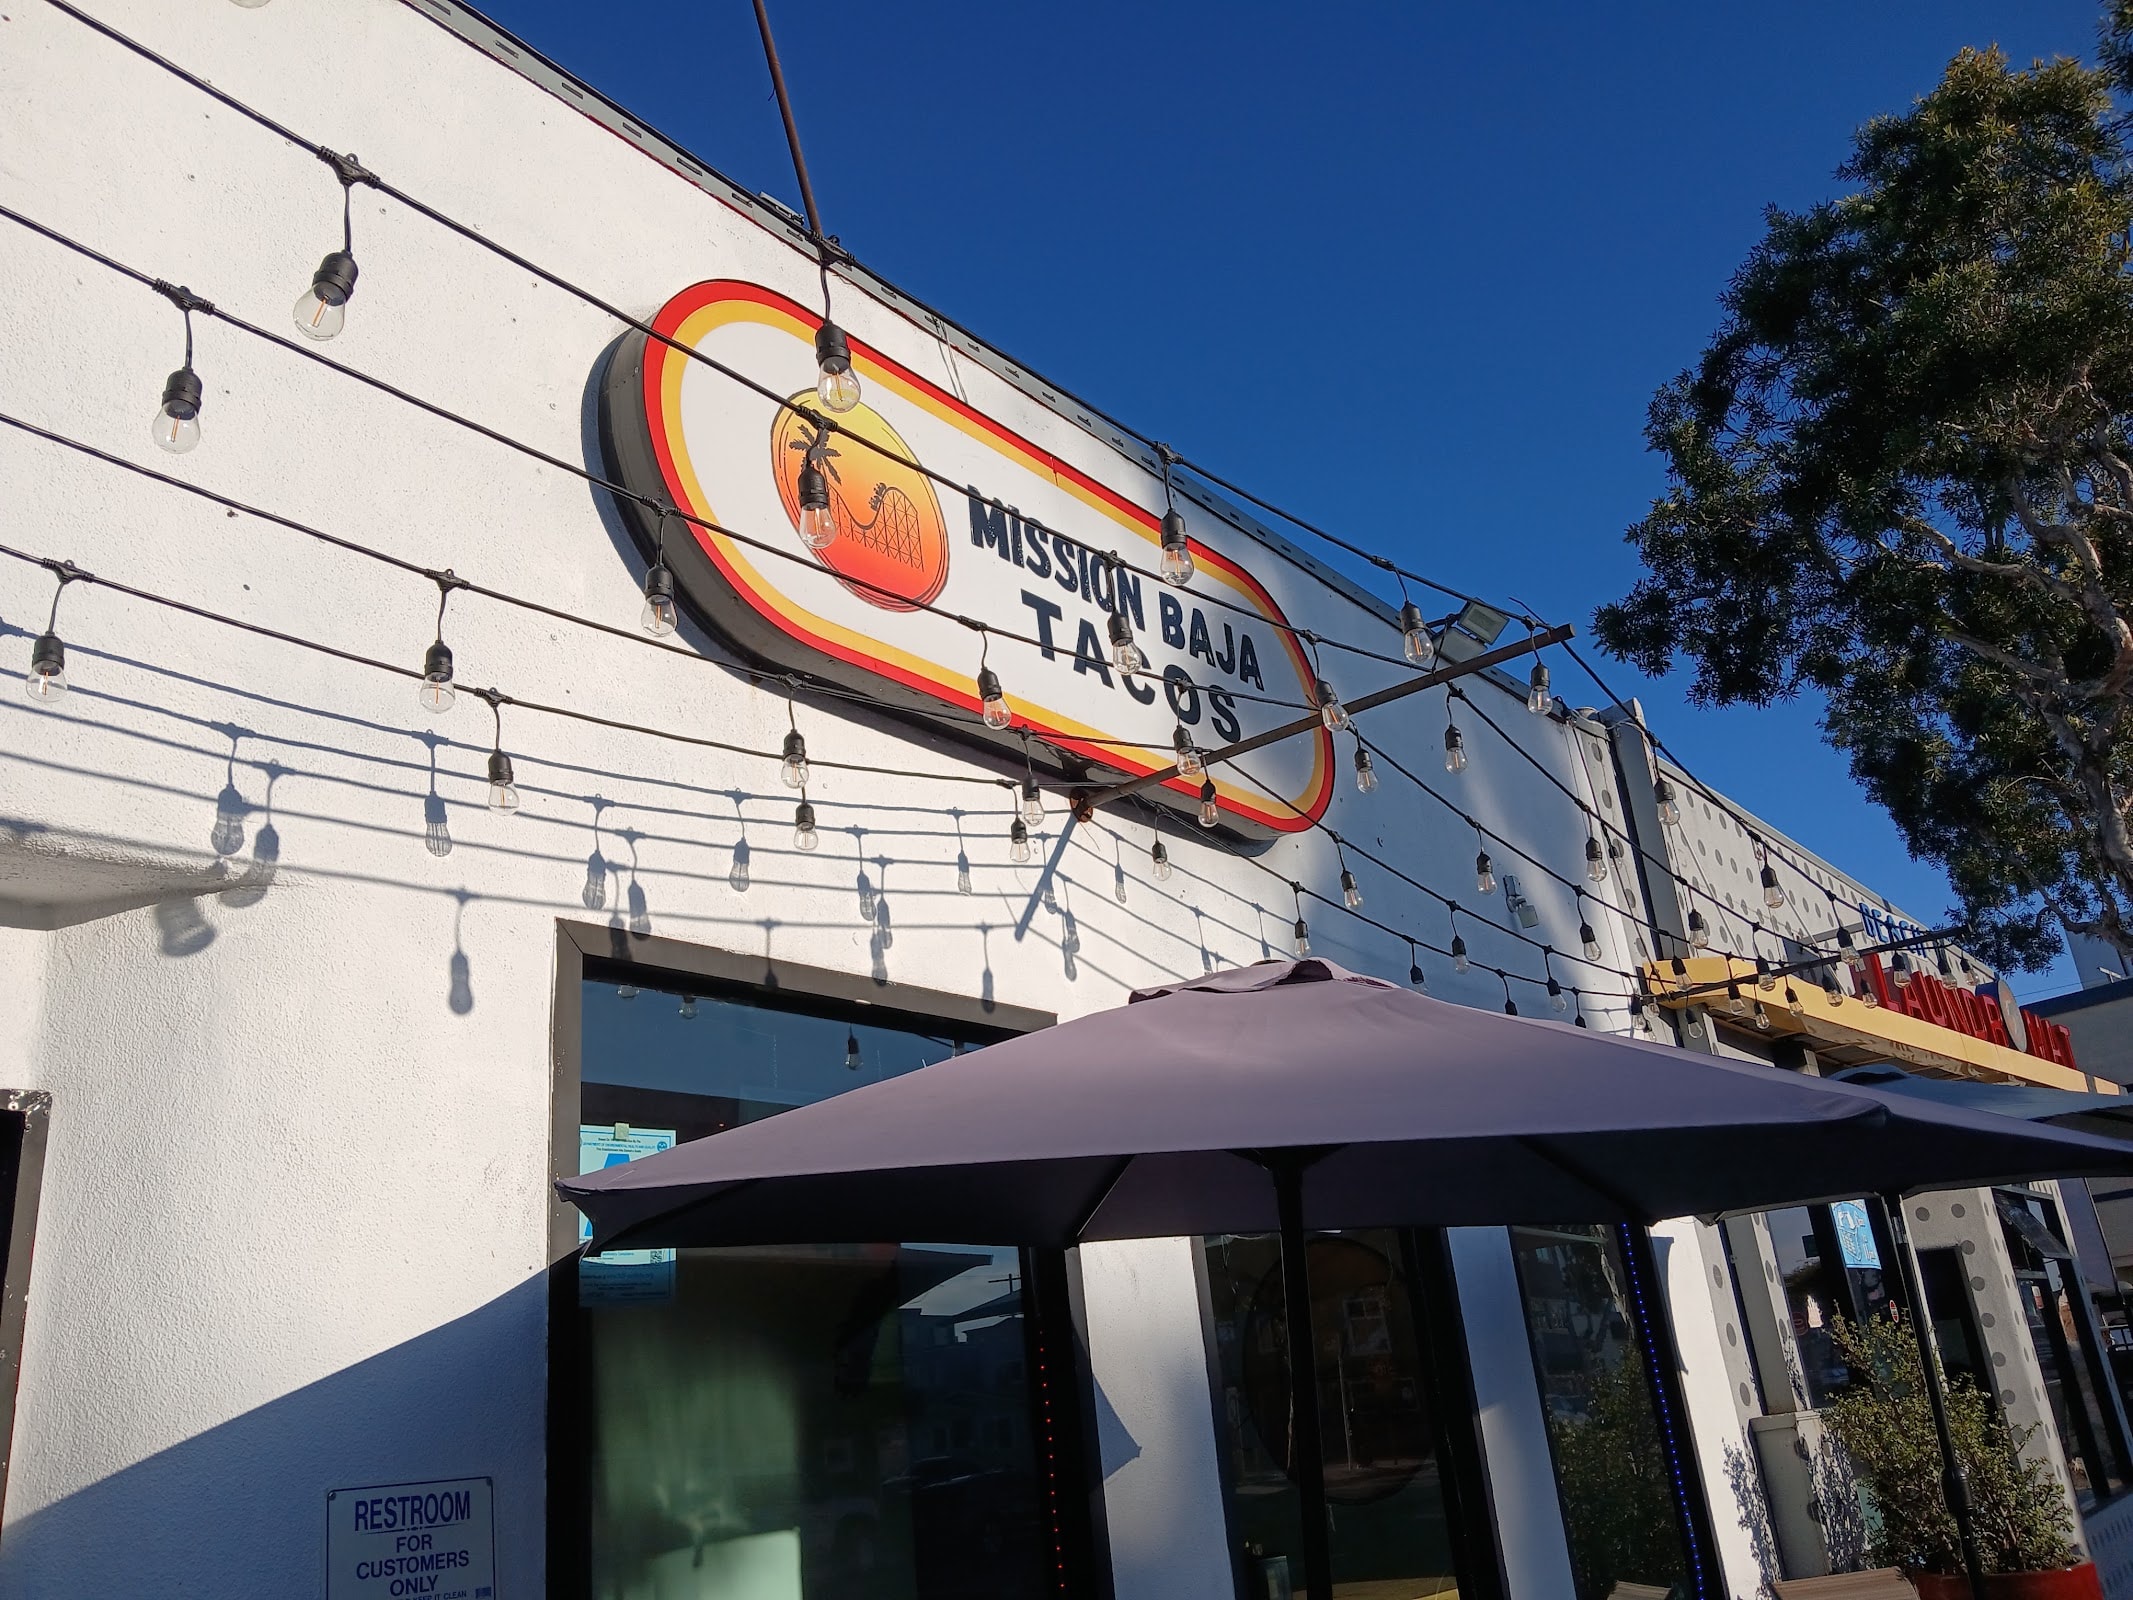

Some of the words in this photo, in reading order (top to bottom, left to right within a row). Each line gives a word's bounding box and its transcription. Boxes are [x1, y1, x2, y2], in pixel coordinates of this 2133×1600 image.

[967, 484, 1146, 631] MISSION
[1158, 591, 1265, 692] BAJA
[1020, 589, 1241, 743] TACOS
[355, 1491, 470, 1531] RESTROOM
[396, 1534, 432, 1553] FOR
[357, 1550, 469, 1579] CUSTOMERS
[390, 1575, 439, 1597] ONLY
[443, 1590, 467, 1600] CLEAN
